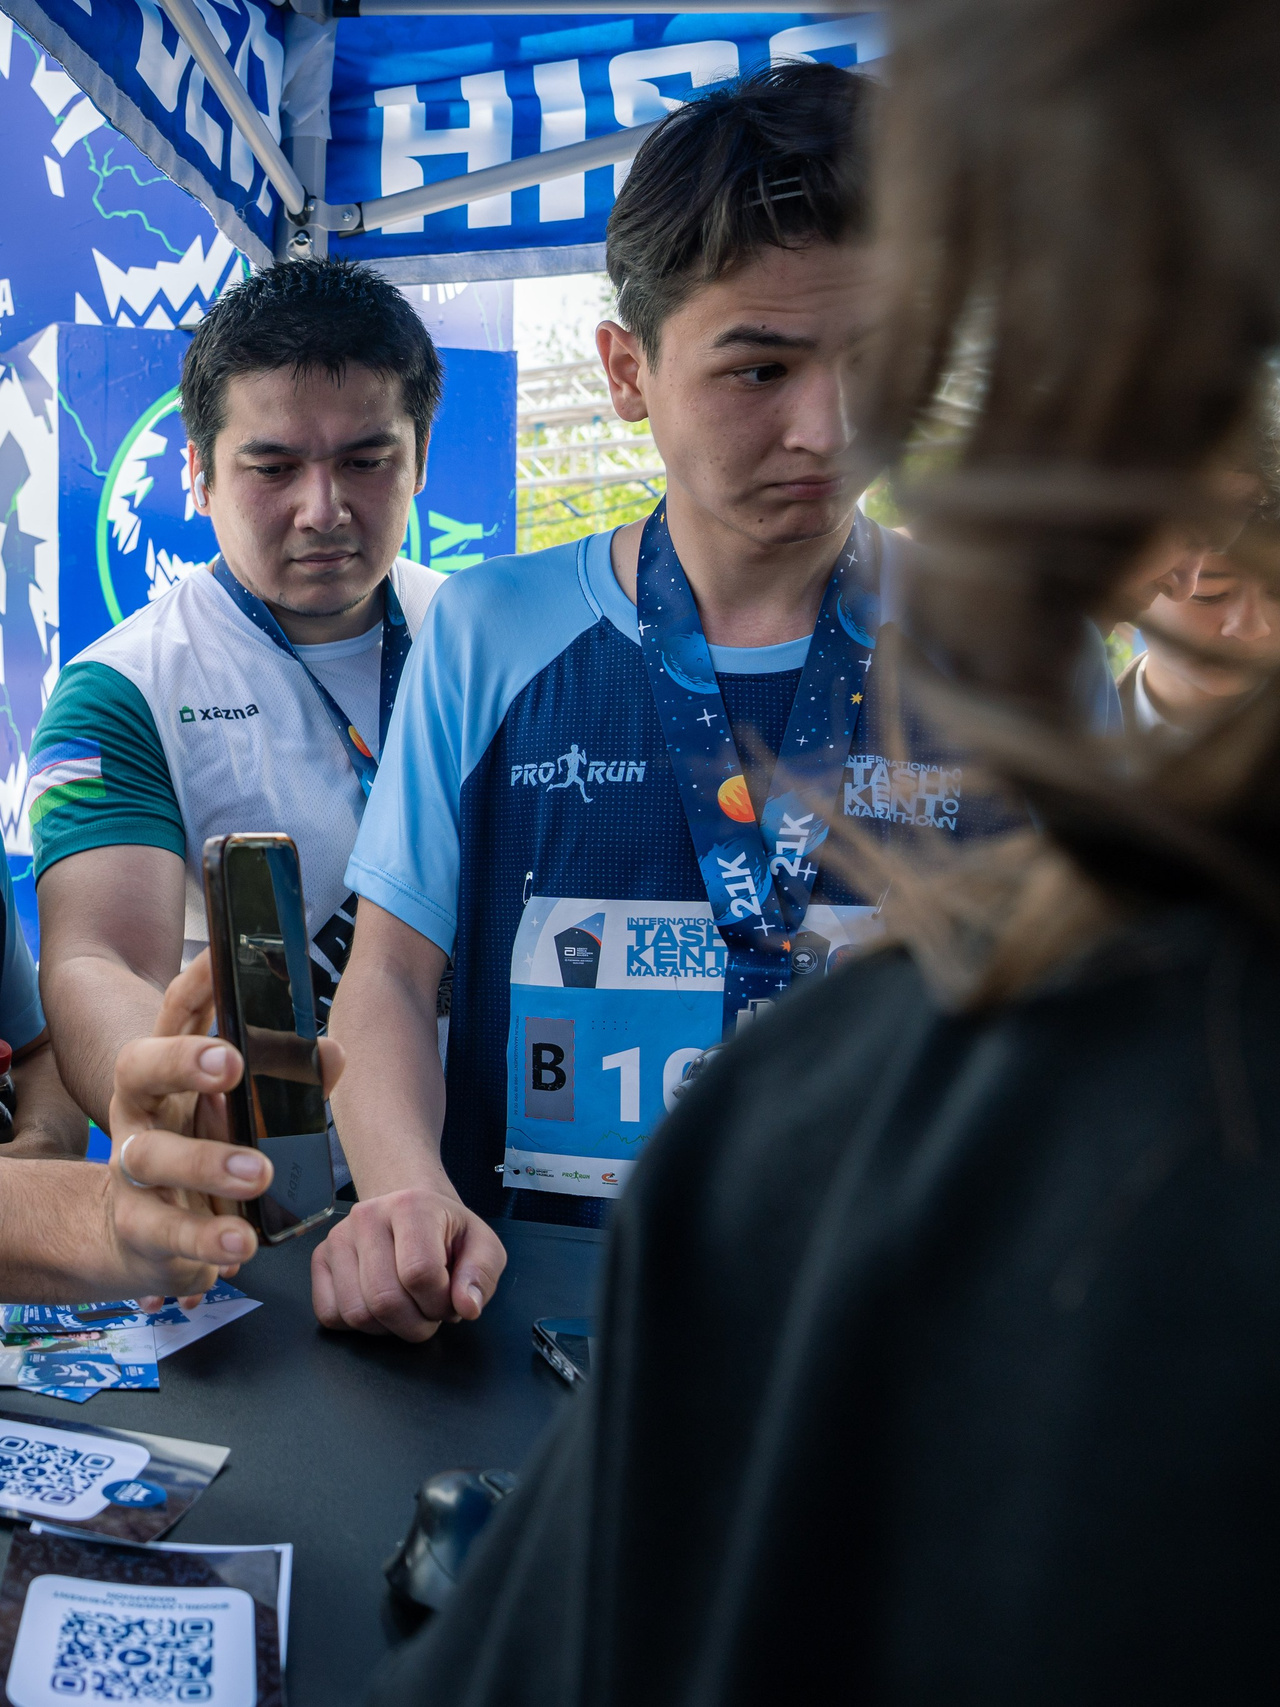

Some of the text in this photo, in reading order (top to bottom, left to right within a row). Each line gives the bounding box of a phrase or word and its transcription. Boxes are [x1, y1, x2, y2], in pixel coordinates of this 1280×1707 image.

[198, 703, 260, 721] xazna
[510, 760, 647, 787] PRO RUN
[846, 754, 945, 773] NTERNATIONAL
[770, 812, 815, 877] 21K
[716, 851, 763, 918] 21K
[626, 917, 716, 926] INTERNATION
[626, 944, 730, 969] KENT
[626, 965, 726, 978] MARATHO
[532, 1042, 567, 1092] B
